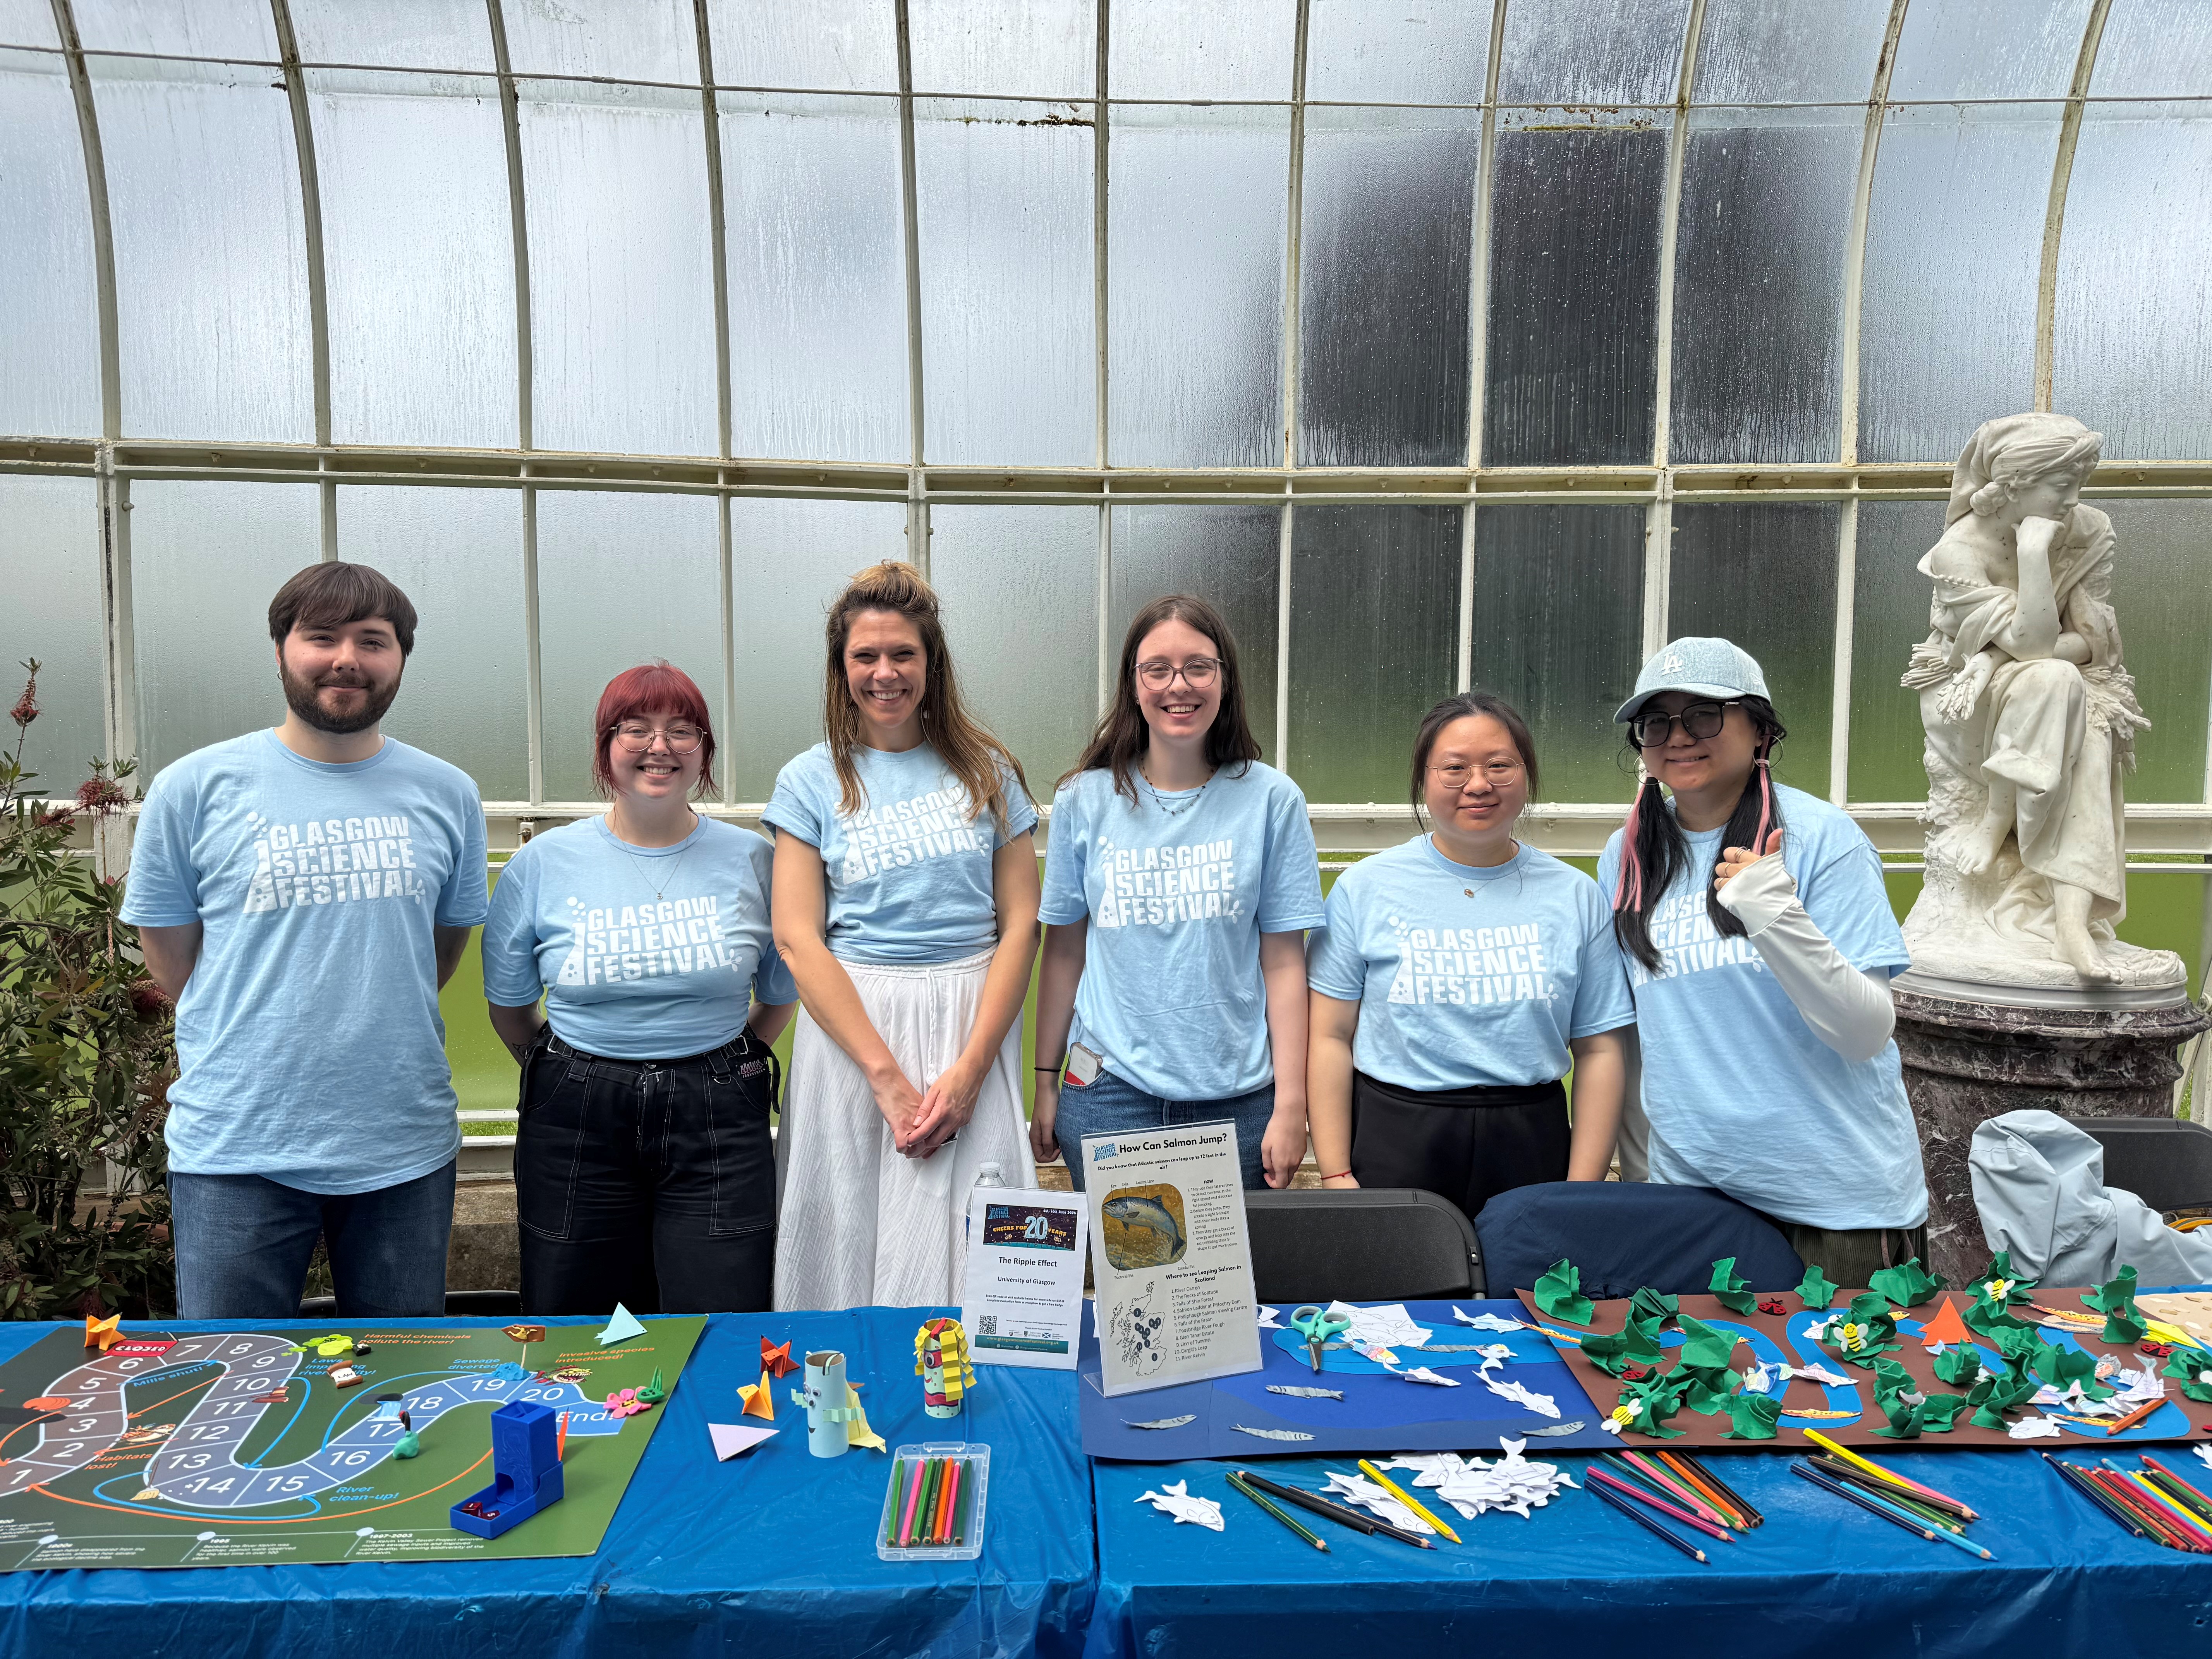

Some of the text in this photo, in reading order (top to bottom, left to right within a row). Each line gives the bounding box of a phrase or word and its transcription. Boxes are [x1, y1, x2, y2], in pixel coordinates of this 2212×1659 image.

[1661, 651, 1683, 676] LA
[854, 787, 965, 829] GLASGOW
[270, 816, 409, 850] GLASGOW
[272, 838, 416, 877] SCIENCE
[864, 829, 981, 876] FESTIVAL
[1115, 839, 1232, 872] GLASGOW
[1116, 861, 1234, 896] SCIENCE
[275, 871, 417, 908] FESTIVAL
[588, 896, 716, 931] GLASGOW
[1118, 892, 1234, 926] FESTIVAL
[587, 915, 725, 955] SCIENCE
[1410, 923, 1539, 950] GLASGOW
[1650, 915, 1718, 949] CIEN
[587, 943, 732, 985] FESTIVAL
[1414, 944, 1546, 975] SCIENCE
[1415, 974, 1549, 1005] FESTIVAL
[1120, 1133, 1227, 1153] How Can Salmon Jump?
[1097, 1152, 1118, 1161] FESTIVAL
[1024, 1216, 1048, 1240] 20
[1048, 1228, 1066, 1237] YEARS
[1014, 1258, 1036, 1266] Ripple
[176, 1345, 202, 1356] 7
[229, 1343, 253, 1354] 8
[119, 1358, 143, 1369] 6
[252, 1356, 275, 1368] 9
[555, 1354, 623, 1363] introduced!
[79, 1377, 106, 1390] 5
[133, 1367, 202, 1387] Mills shut!
[233, 1378, 270, 1391] 10
[471, 1379, 506, 1391] 19
[524, 1388, 564, 1401] 20
[68, 1397, 96, 1409] 4
[213, 1401, 247, 1415] 11
[407, 1397, 443, 1410] 18
[69, 1419, 97, 1432] 3
[189, 1426, 230, 1440] 12
[369, 1423, 405, 1437] 17
[52, 1443, 84, 1457] 2
[94, 1454, 152, 1462] Habitats
[168, 1453, 211, 1469] 13
[330, 1450, 370, 1466] 16
[10, 1469, 32, 1484] 1
[266, 1476, 309, 1491] 15
[192, 1478, 235, 1493] 14
[329, 1493, 399, 1501] clean-up!
